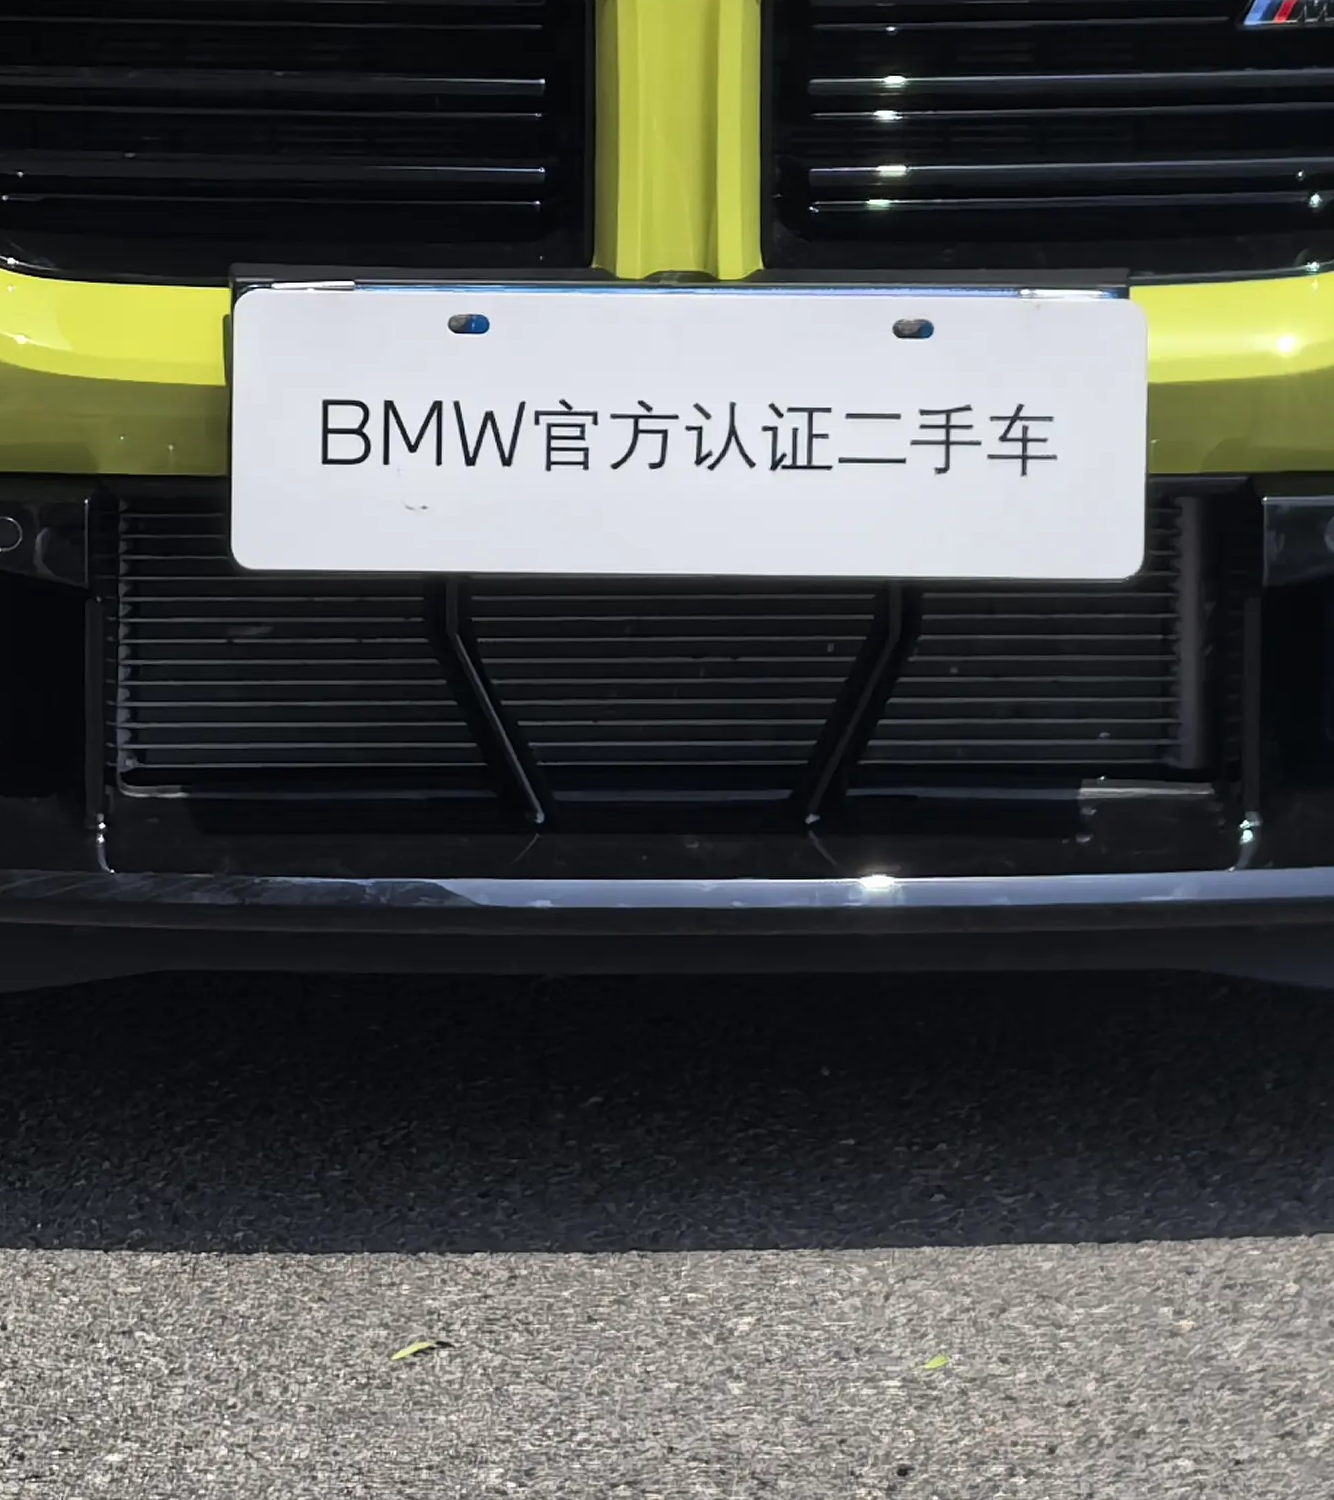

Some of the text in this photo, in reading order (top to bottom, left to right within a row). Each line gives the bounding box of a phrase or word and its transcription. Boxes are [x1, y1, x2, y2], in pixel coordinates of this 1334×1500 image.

[320, 398, 1059, 477] BMW官方认证二手车
